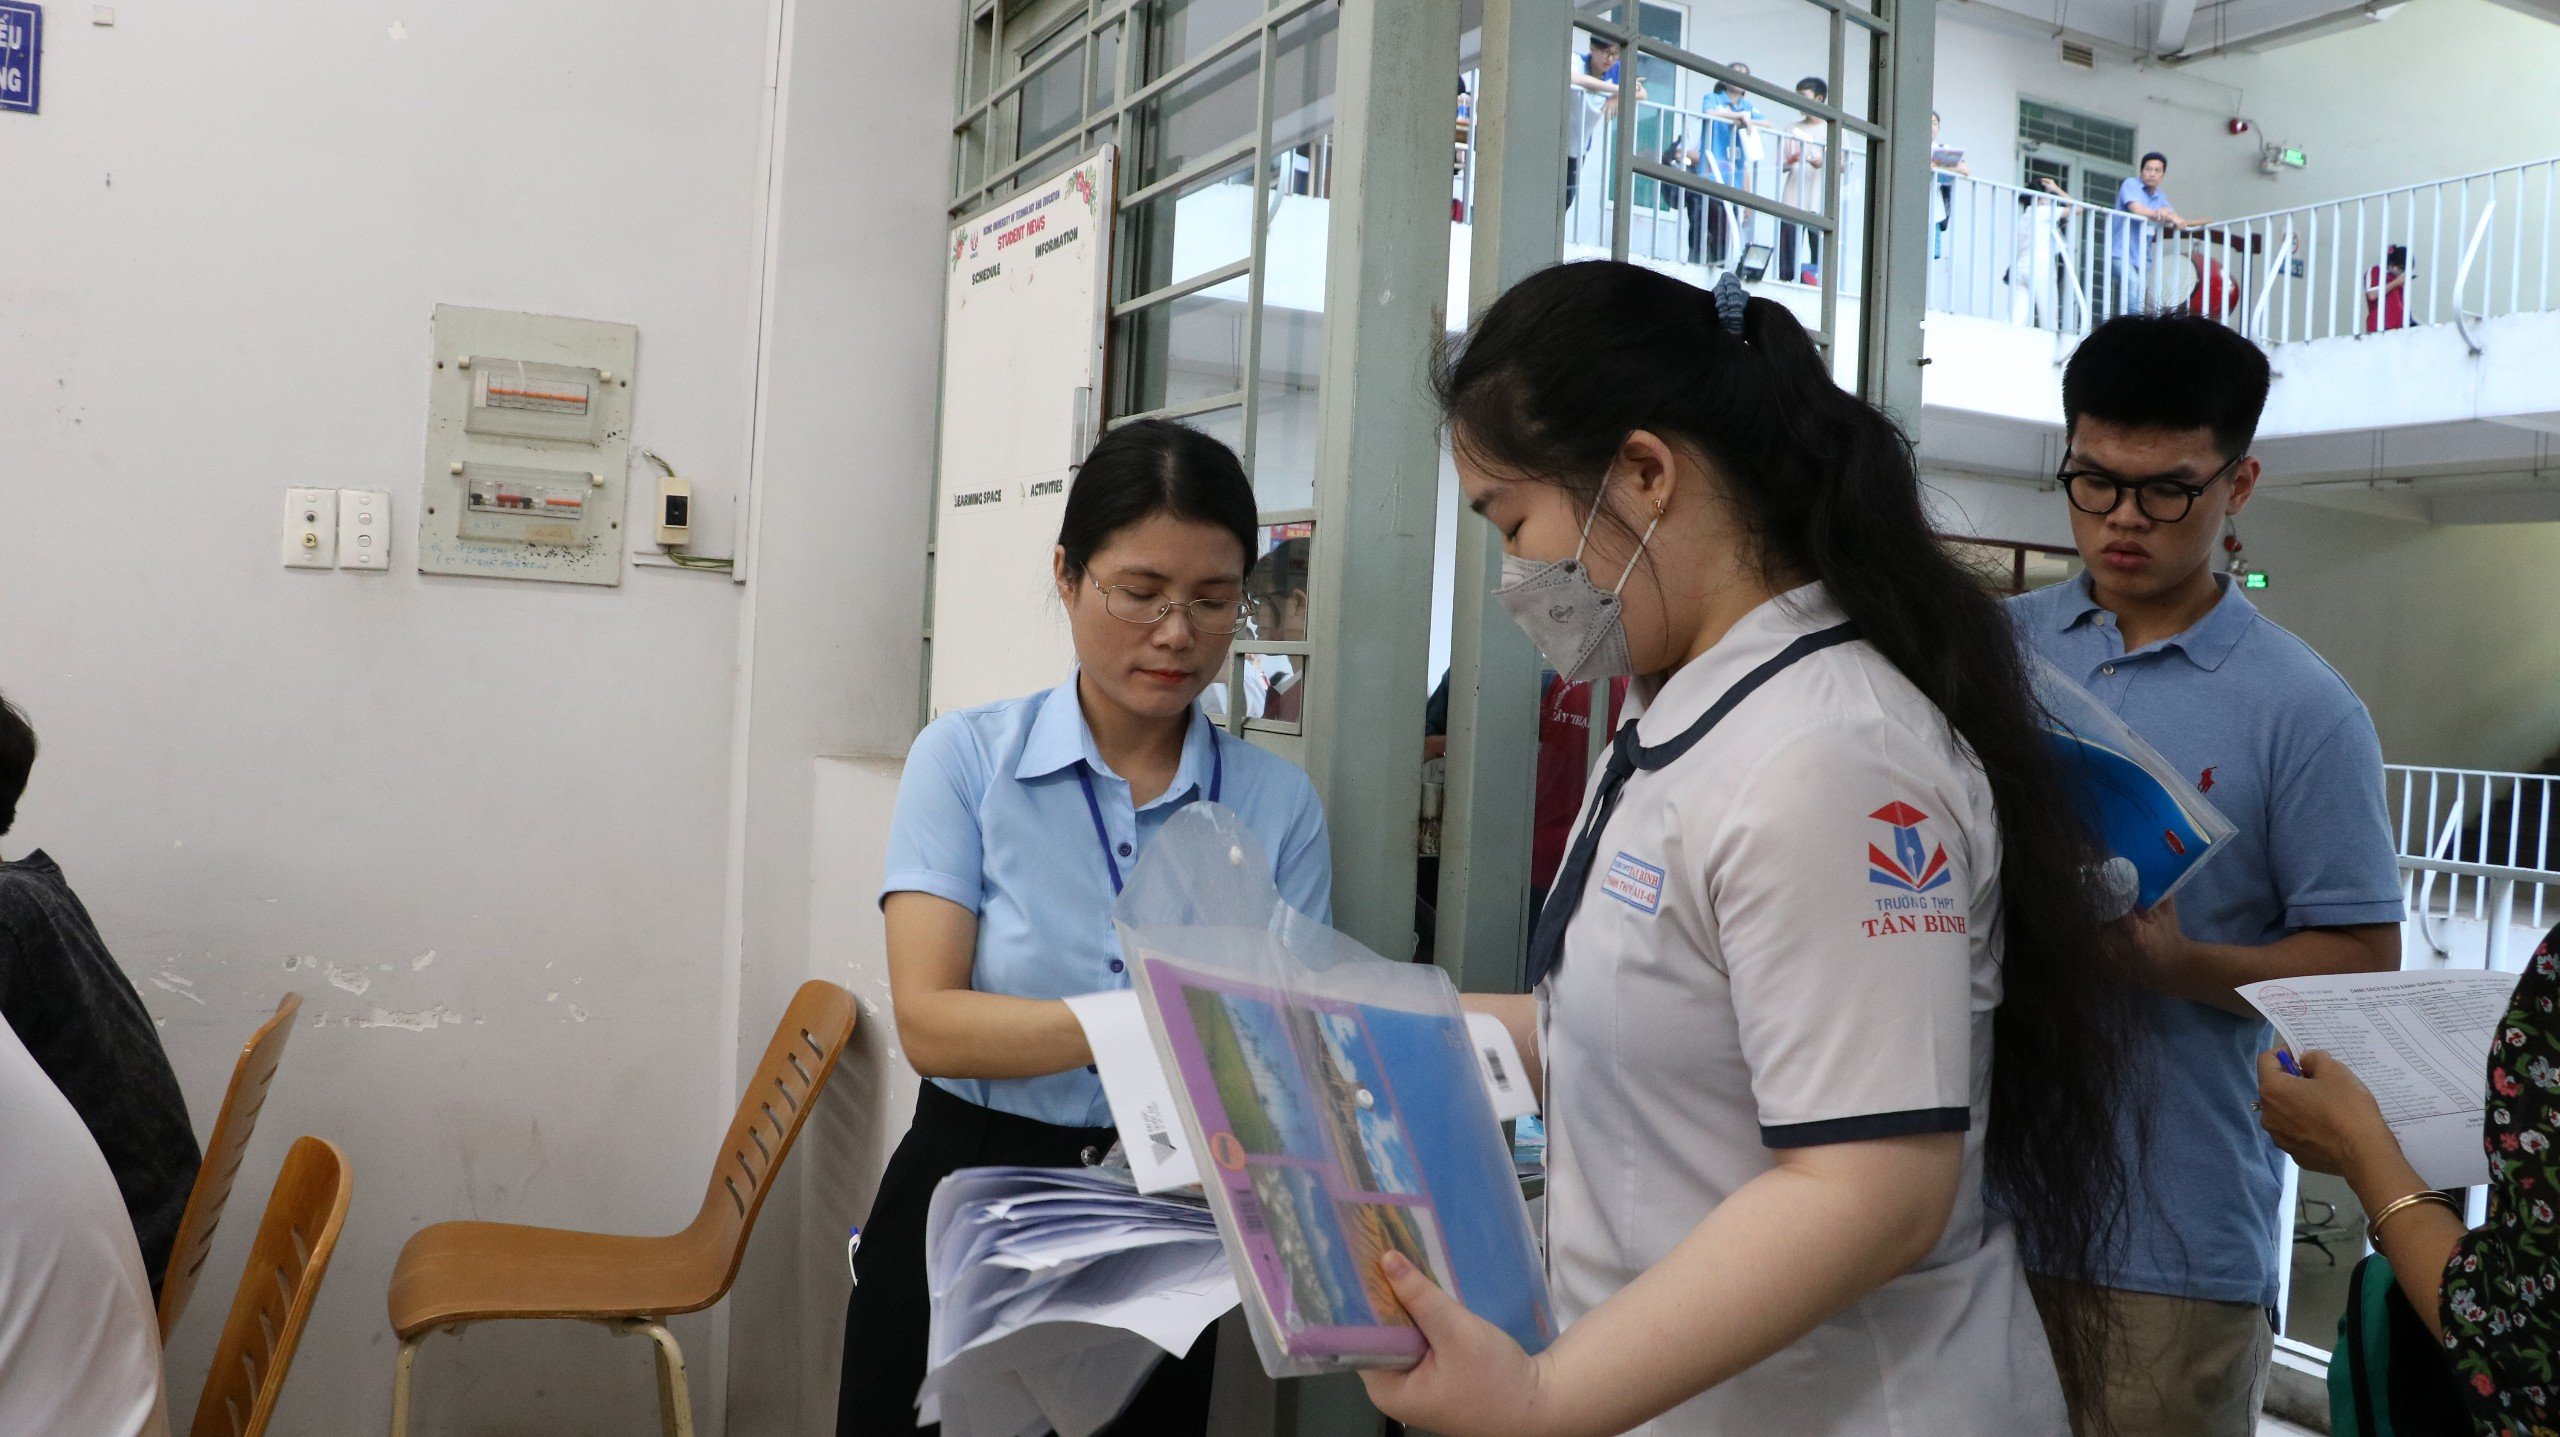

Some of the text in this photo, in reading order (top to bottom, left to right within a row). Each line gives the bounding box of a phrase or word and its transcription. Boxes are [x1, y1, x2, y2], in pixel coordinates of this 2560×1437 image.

[993, 215, 1011, 231] UNIVERSITY
[1015, 203, 1035, 220] TECHNOLOGY
[1042, 190, 1060, 207] EDUCATION
[997, 214, 1046, 251] STUDENT NEWS
[1035, 226, 1079, 259] INFORMATION
[971, 262, 1001, 285] SCHEDULE
[983, 489, 1002, 504] SPACE
[1030, 479, 1063, 497] ACTIVITIES
[1570, 714, 1590, 728] THẠ
[1639, 869, 1659, 886] BÌNH
[1875, 894, 1954, 911] TRƯỜNG THPT
[1862, 910, 1967, 937] TÂN BÌNH
